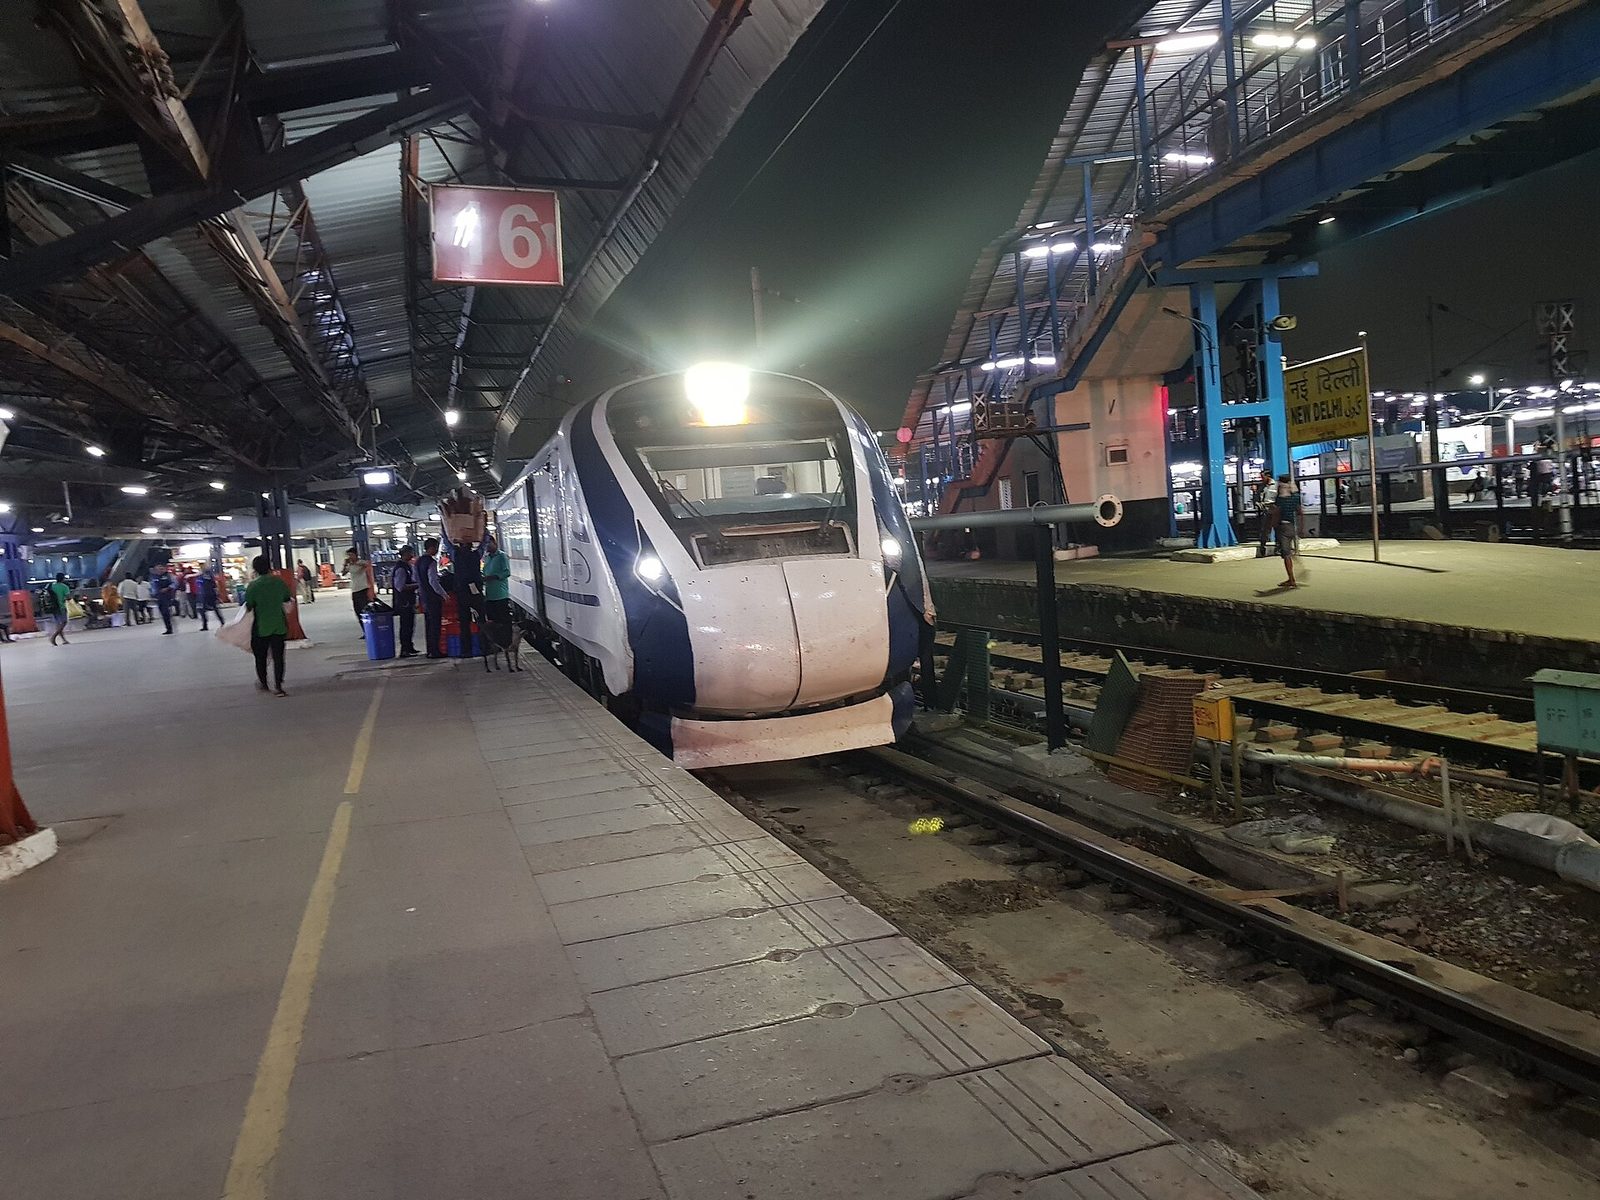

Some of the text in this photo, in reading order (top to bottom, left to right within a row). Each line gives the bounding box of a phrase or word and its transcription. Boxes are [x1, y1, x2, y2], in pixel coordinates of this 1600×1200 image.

[1289, 358, 1360, 401] नई दिल्ली
[1290, 404, 1311, 426] NEW
[1313, 397, 1343, 421] DELHI
